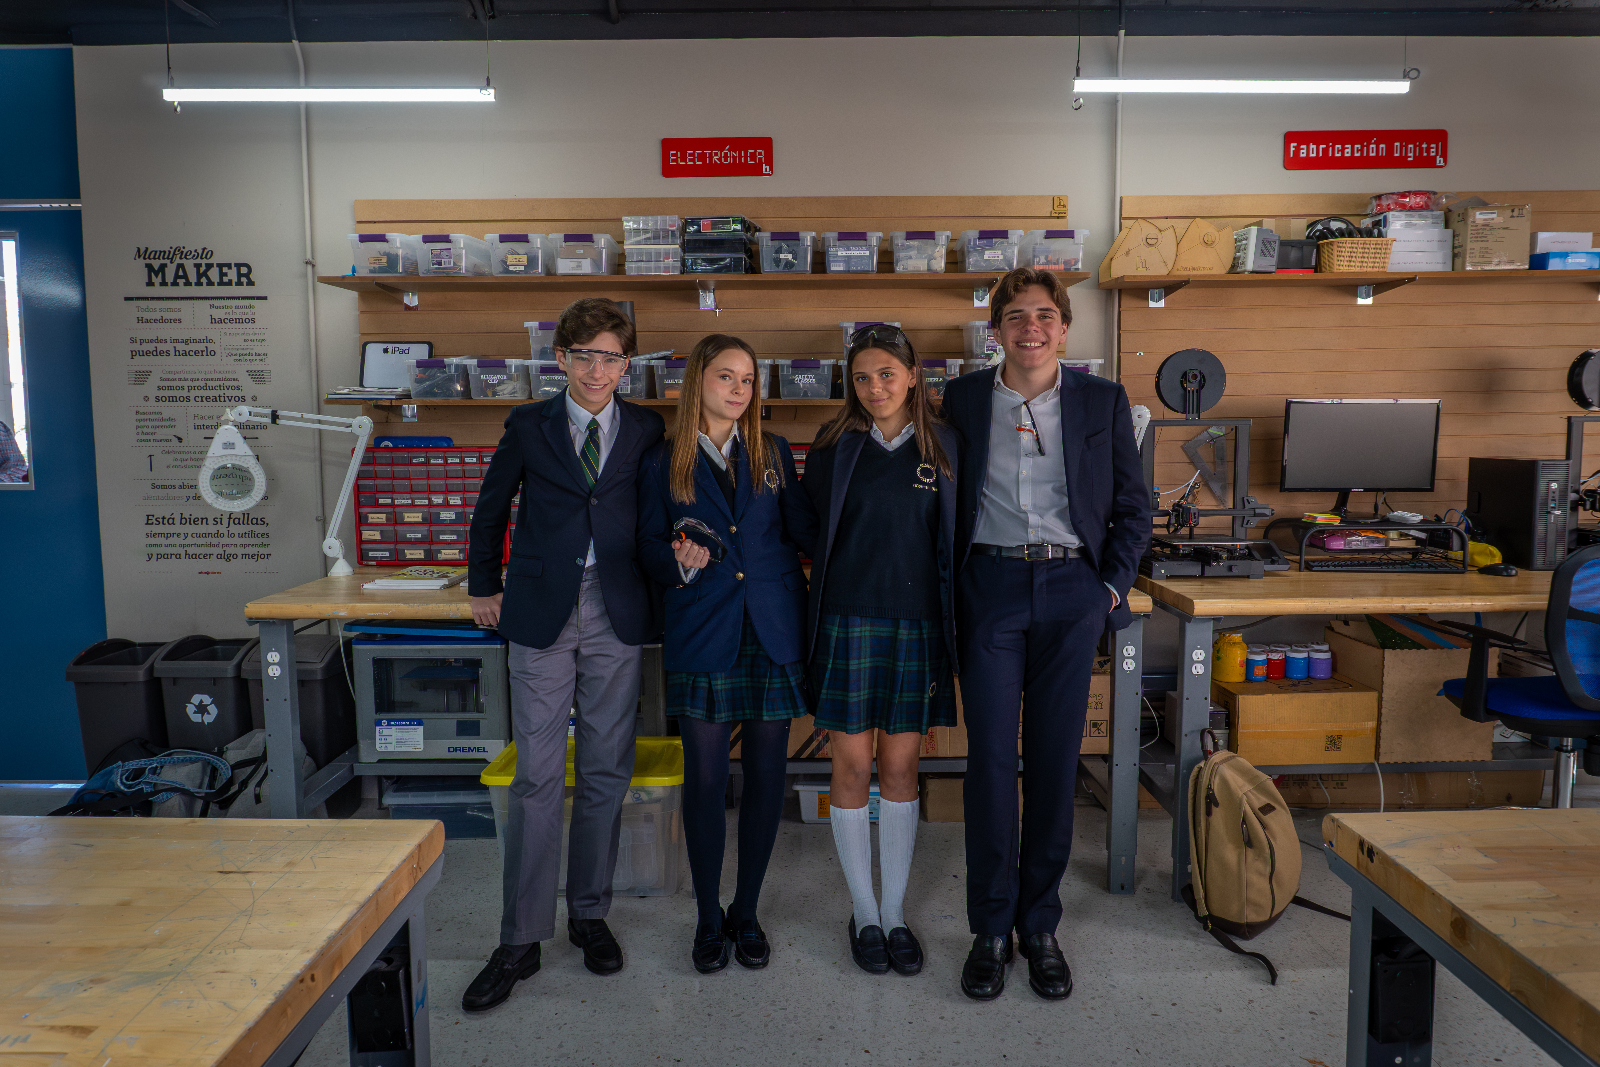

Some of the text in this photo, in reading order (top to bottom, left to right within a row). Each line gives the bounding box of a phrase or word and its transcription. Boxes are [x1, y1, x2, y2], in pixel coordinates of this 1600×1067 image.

[1290, 138, 1442, 160] Fabricación Digital
[669, 145, 764, 164] ELECTRÓNICA
[134, 246, 214, 264] Manifiesto
[145, 263, 256, 287] MAKER
[136, 305, 156, 313] Todos
[136, 316, 182, 324] Hacedores
[210, 314, 256, 324] hacemos
[139, 336, 168, 345] puedes
[170, 336, 216, 345] imaginarlo,
[130, 346, 216, 359] puedes hacerlo
[391, 346, 410, 355] iPad
[187, 383, 243, 393] productivos;
[155, 393, 246, 403] somos creativos
[145, 513, 269, 528] Está bien si fallas,
[145, 530, 270, 540] siempre y cuando lo utilices
[146, 550, 271, 562] y para hacer algo mejor
